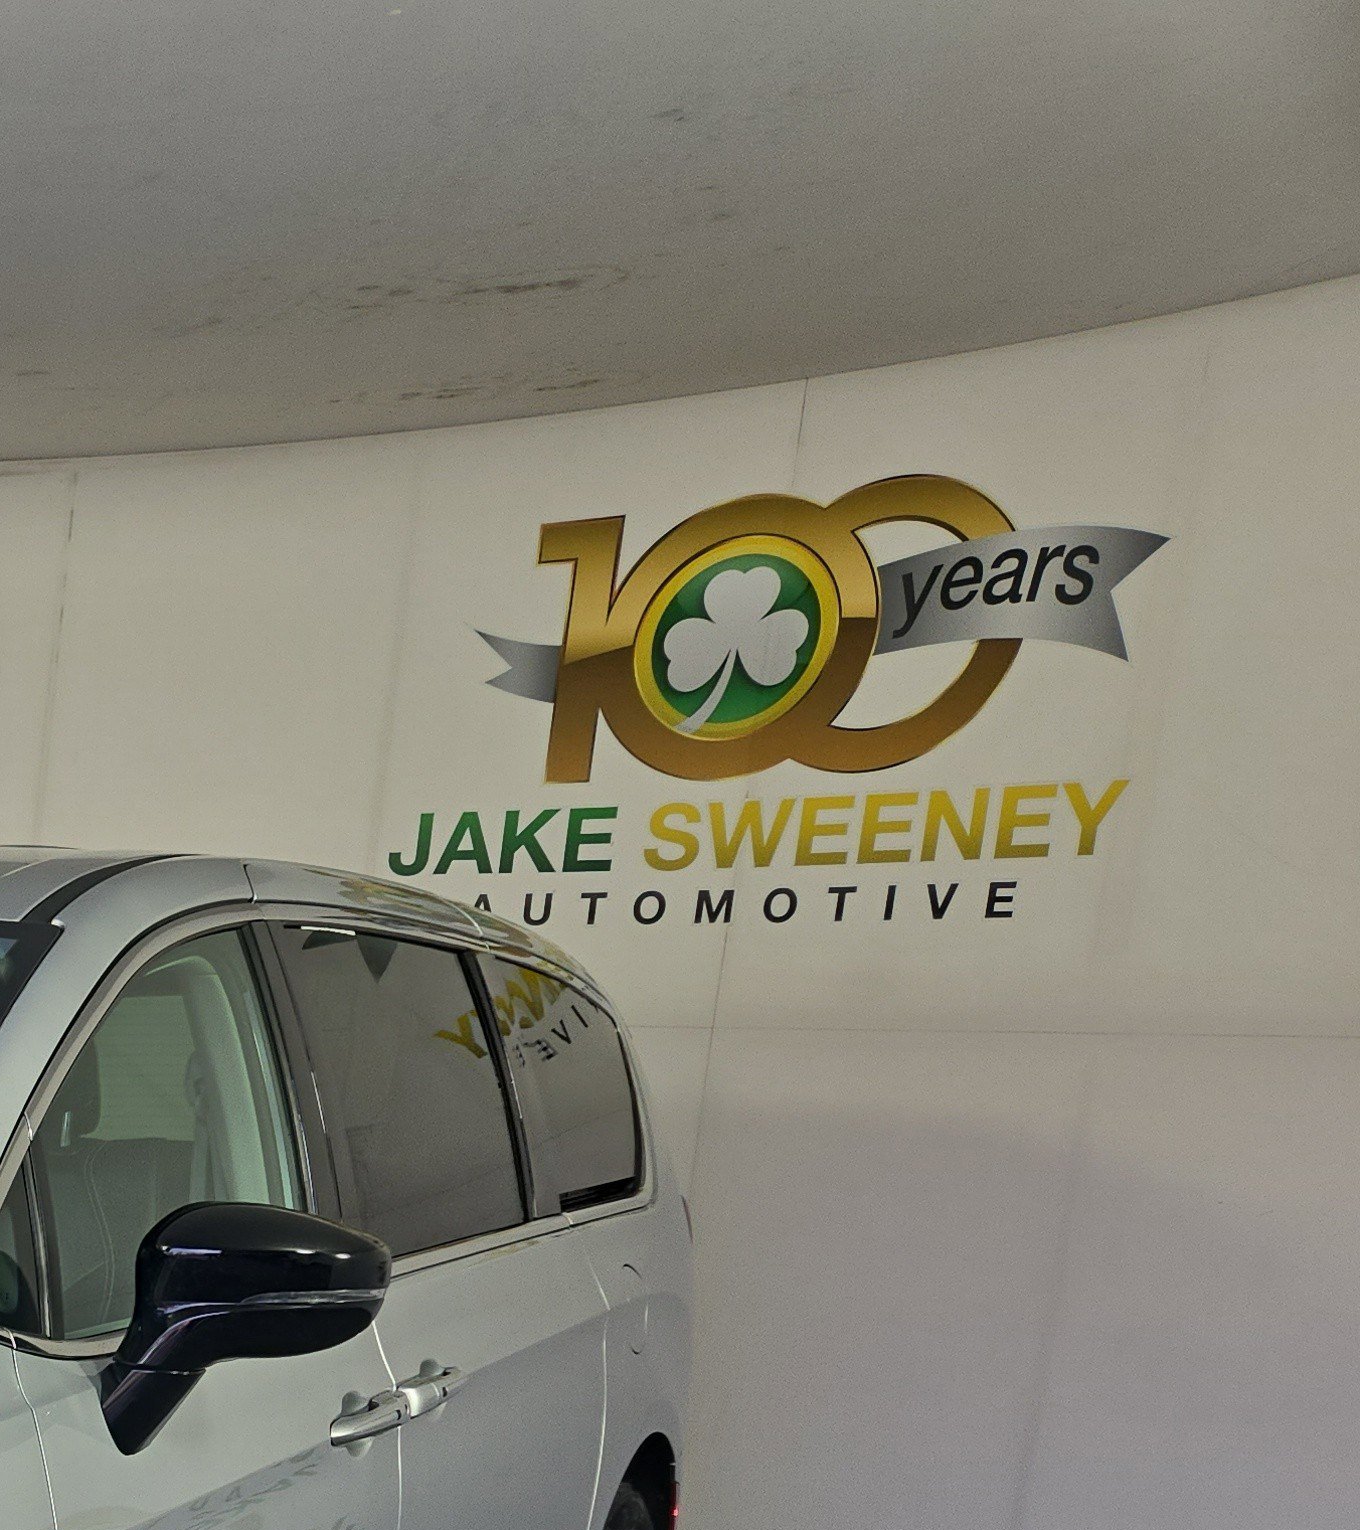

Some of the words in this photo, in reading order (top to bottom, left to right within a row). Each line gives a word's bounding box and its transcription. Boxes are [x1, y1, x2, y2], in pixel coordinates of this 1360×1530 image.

[890, 543, 1101, 638] years
[387, 806, 618, 877] JAKE
[643, 778, 1131, 872] SWEENEY
[474, 880, 1018, 927] AUTOMOTIVE
